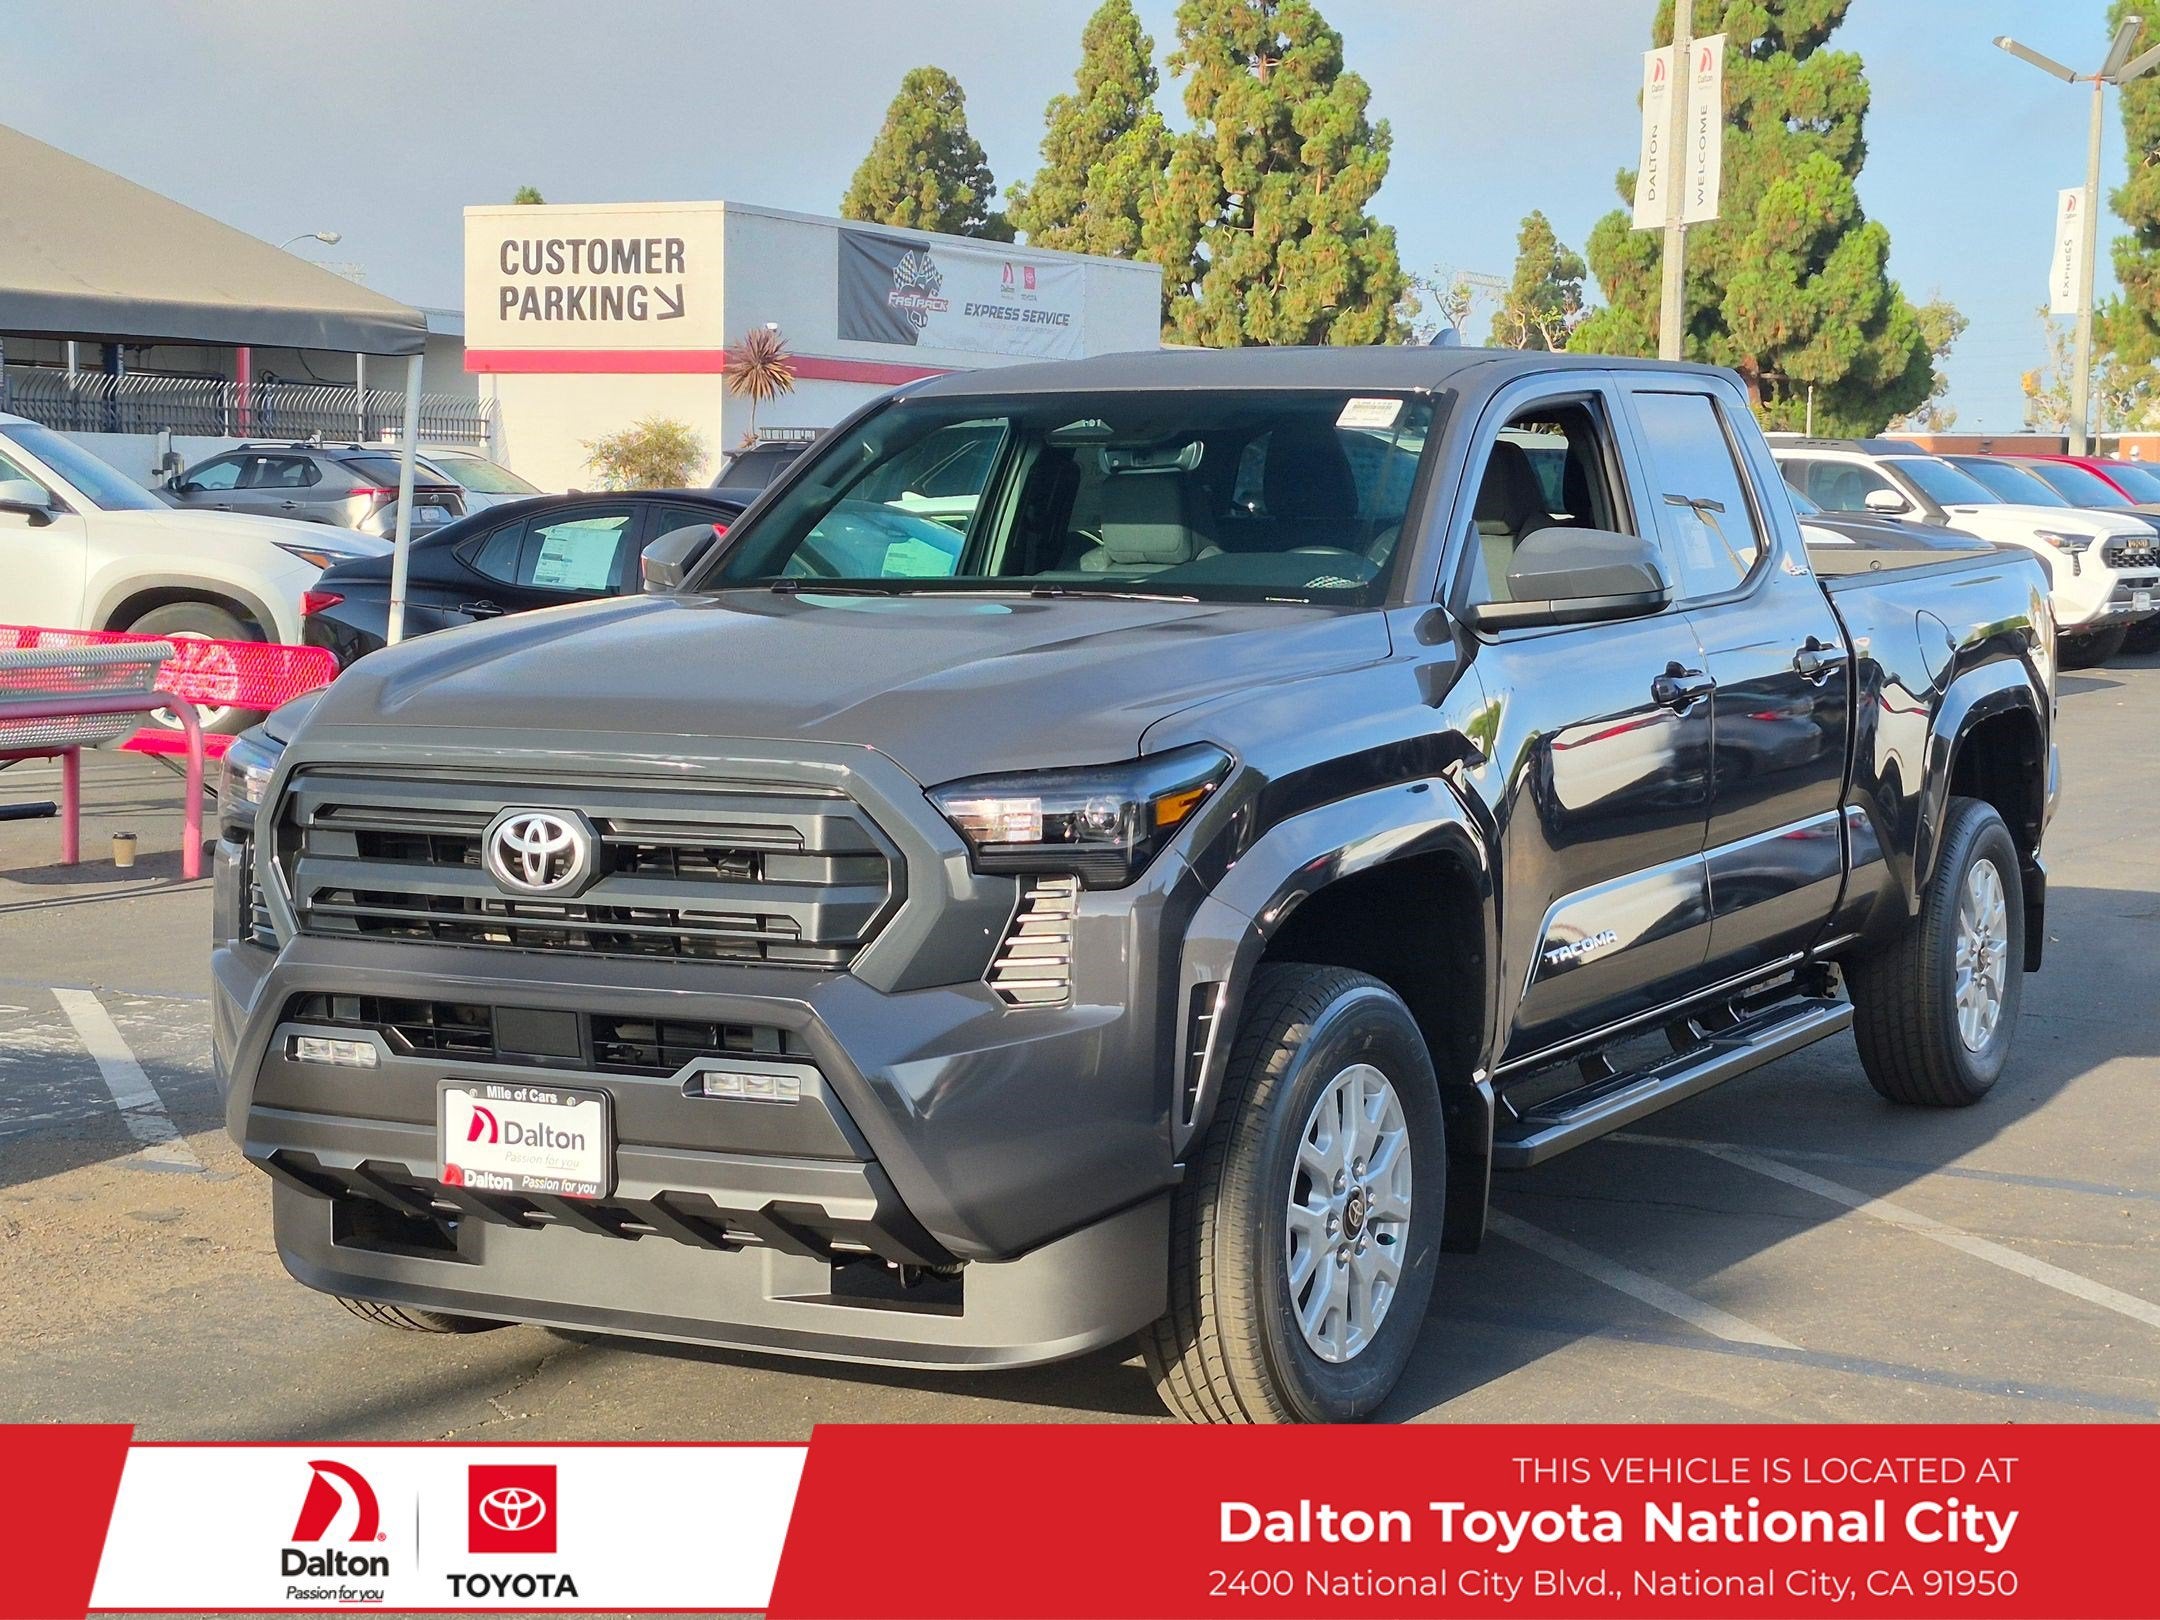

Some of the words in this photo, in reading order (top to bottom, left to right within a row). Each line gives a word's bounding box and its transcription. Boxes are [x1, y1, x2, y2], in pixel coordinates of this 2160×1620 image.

[1648, 124, 1658, 201] DALTON
[1697, 104, 1708, 206] WELCOME
[500, 238, 685, 275] CUSTOMER
[500, 285, 648, 321] PARKING
[964, 302, 1021, 321] EXPRESS
[1021, 309, 1071, 327] SERVICE
[1544, 928, 1618, 965] TACOMA
[486, 1085, 511, 1100] Mile
[514, 1088, 527, 1101] of
[529, 1088, 558, 1104] Cars
[504, 1120, 585, 1151] Dalton
[505, 1151, 544, 1166] Passion
[544, 1153, 560, 1168] for
[560, 1158, 580, 1169] you
[464, 1169, 513, 1191] Dalton
[522, 1175, 559, 1191] Passion
[560, 1178, 576, 1193] for
[576, 1183, 597, 1195] you
